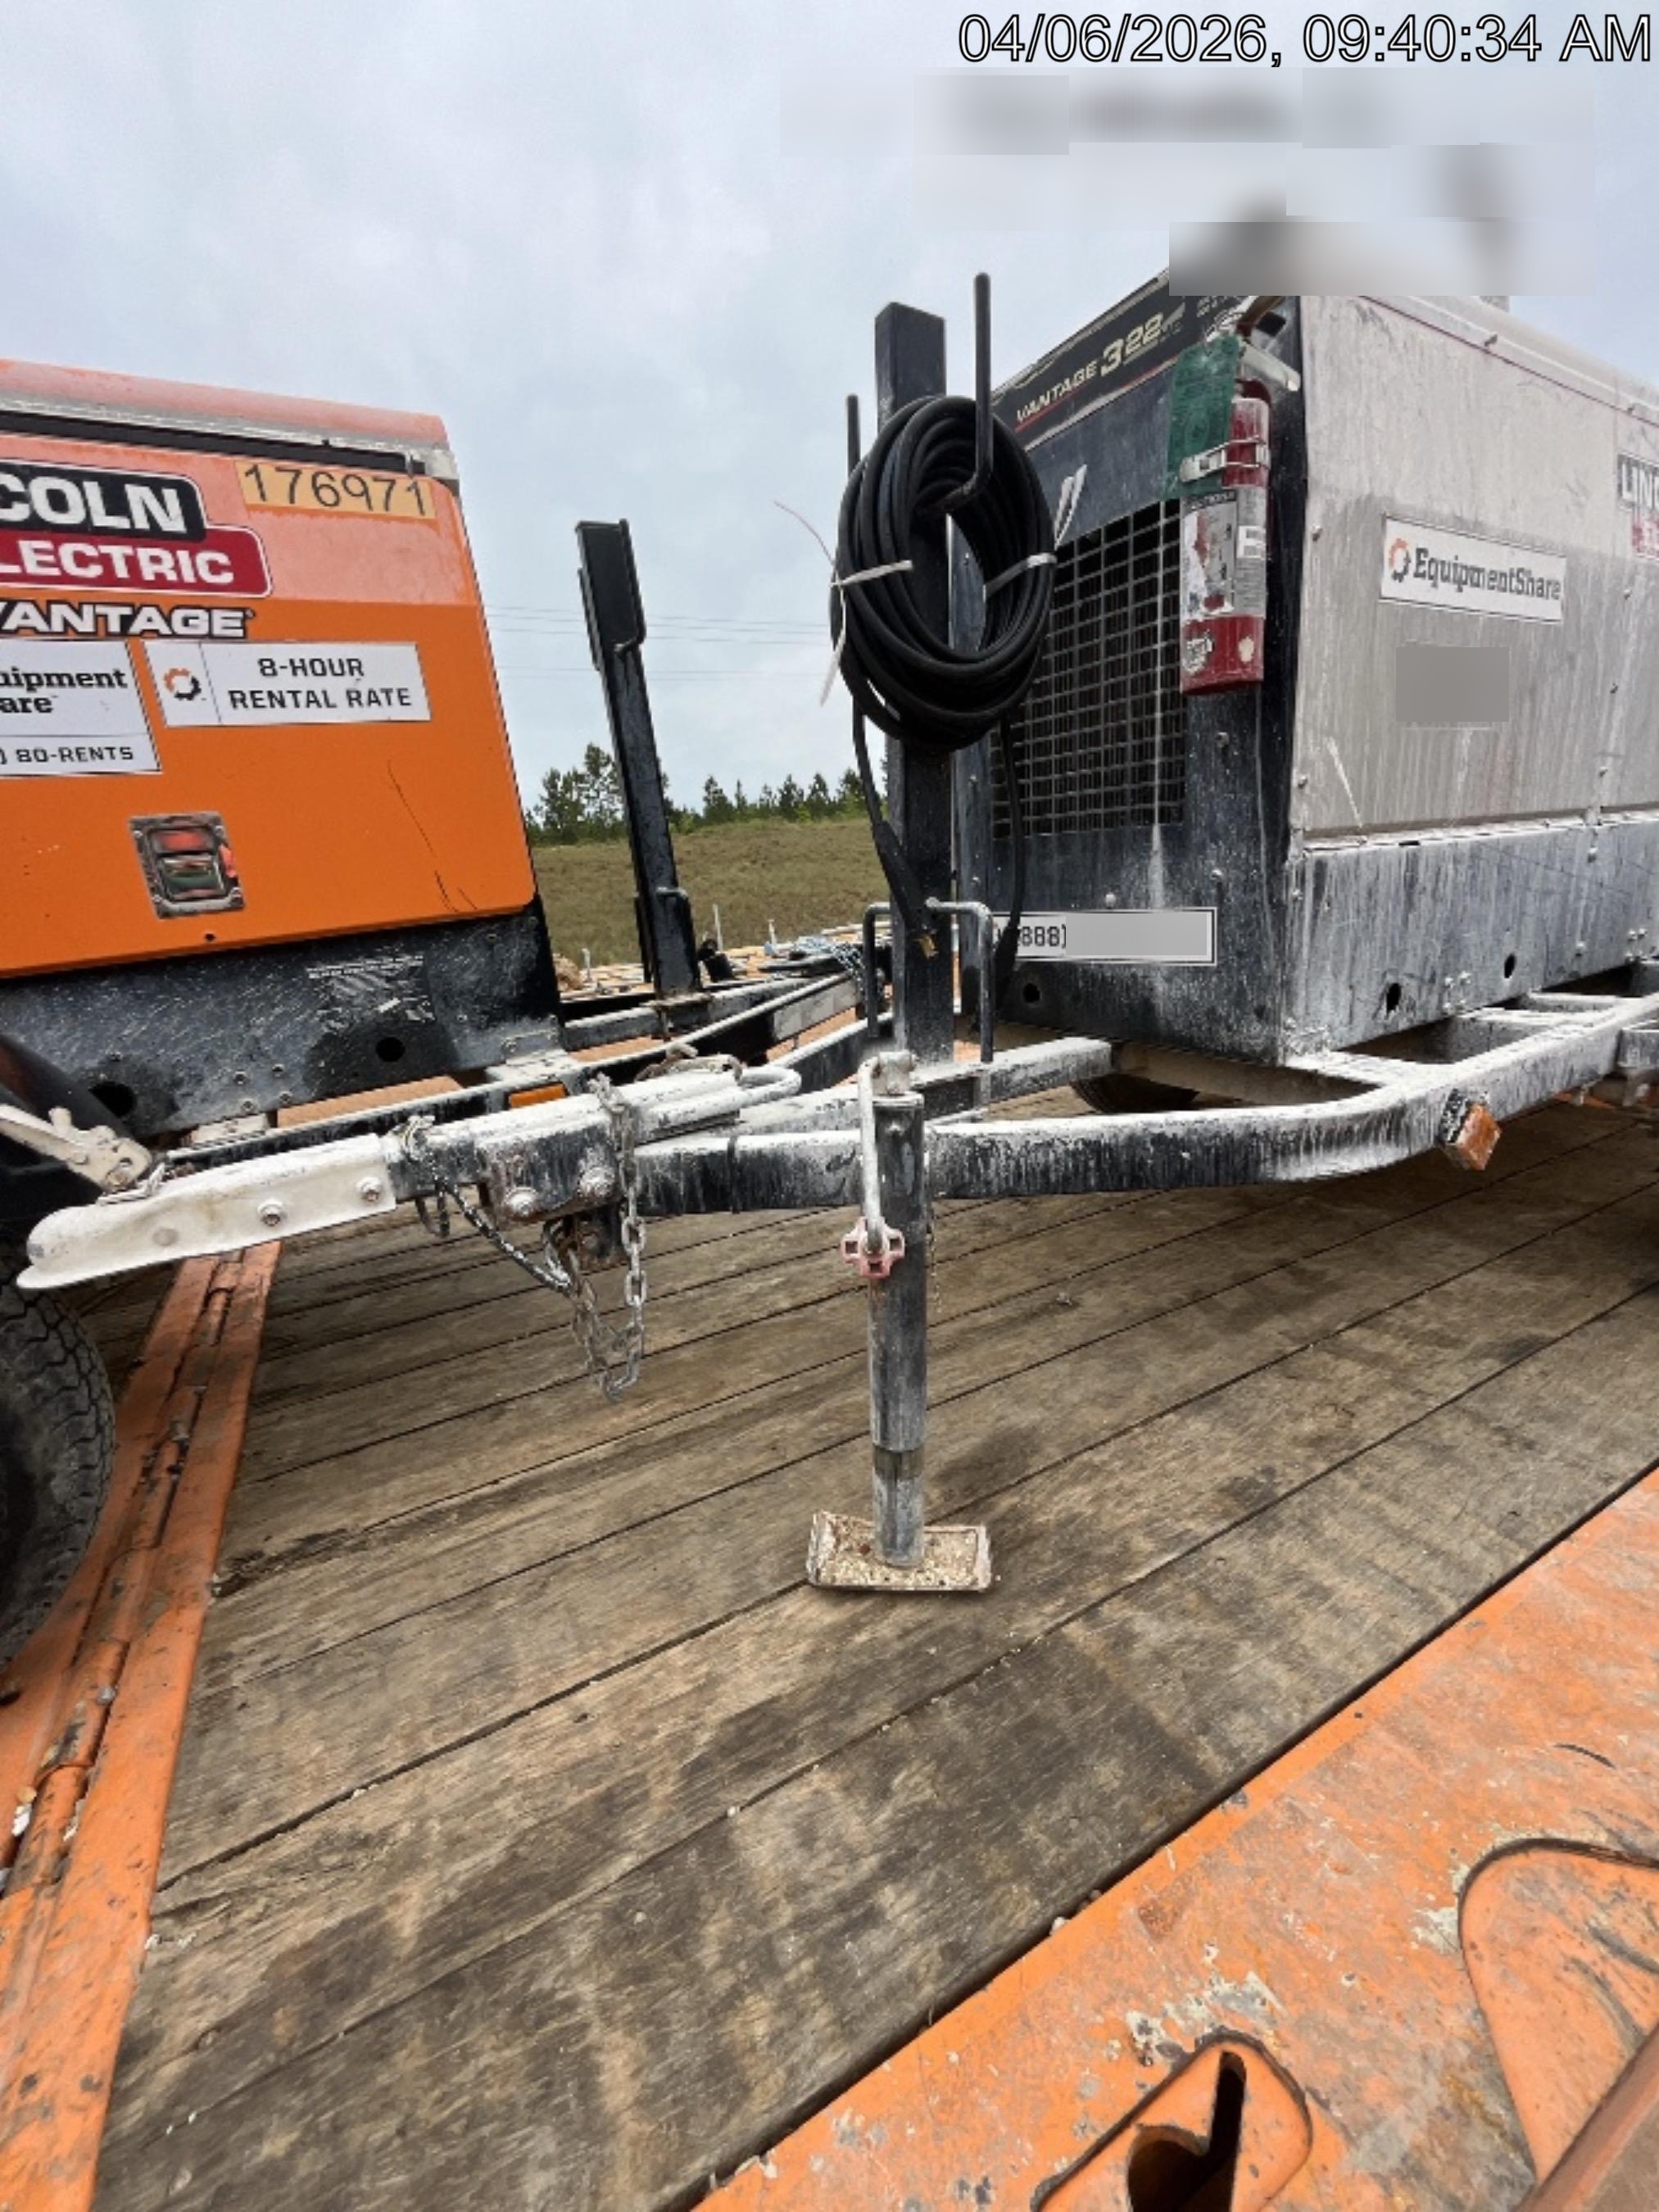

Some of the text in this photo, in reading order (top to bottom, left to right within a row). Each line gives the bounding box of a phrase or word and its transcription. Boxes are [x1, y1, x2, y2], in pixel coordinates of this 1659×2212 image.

[1017, 312, 1164, 423] VANTAGE 322
[244, 464, 427, 515] 176971
[1412, 547, 1561, 601] EquipmentShare
[0, 601, 245, 637] ANTAGE
[258, 658, 365, 678] 8-HOUR
[228, 687, 412, 709] RENTAL RATE
[16, 746, 134, 763] 80-RENTS
[1018, 923, 1066, 949] 888)
